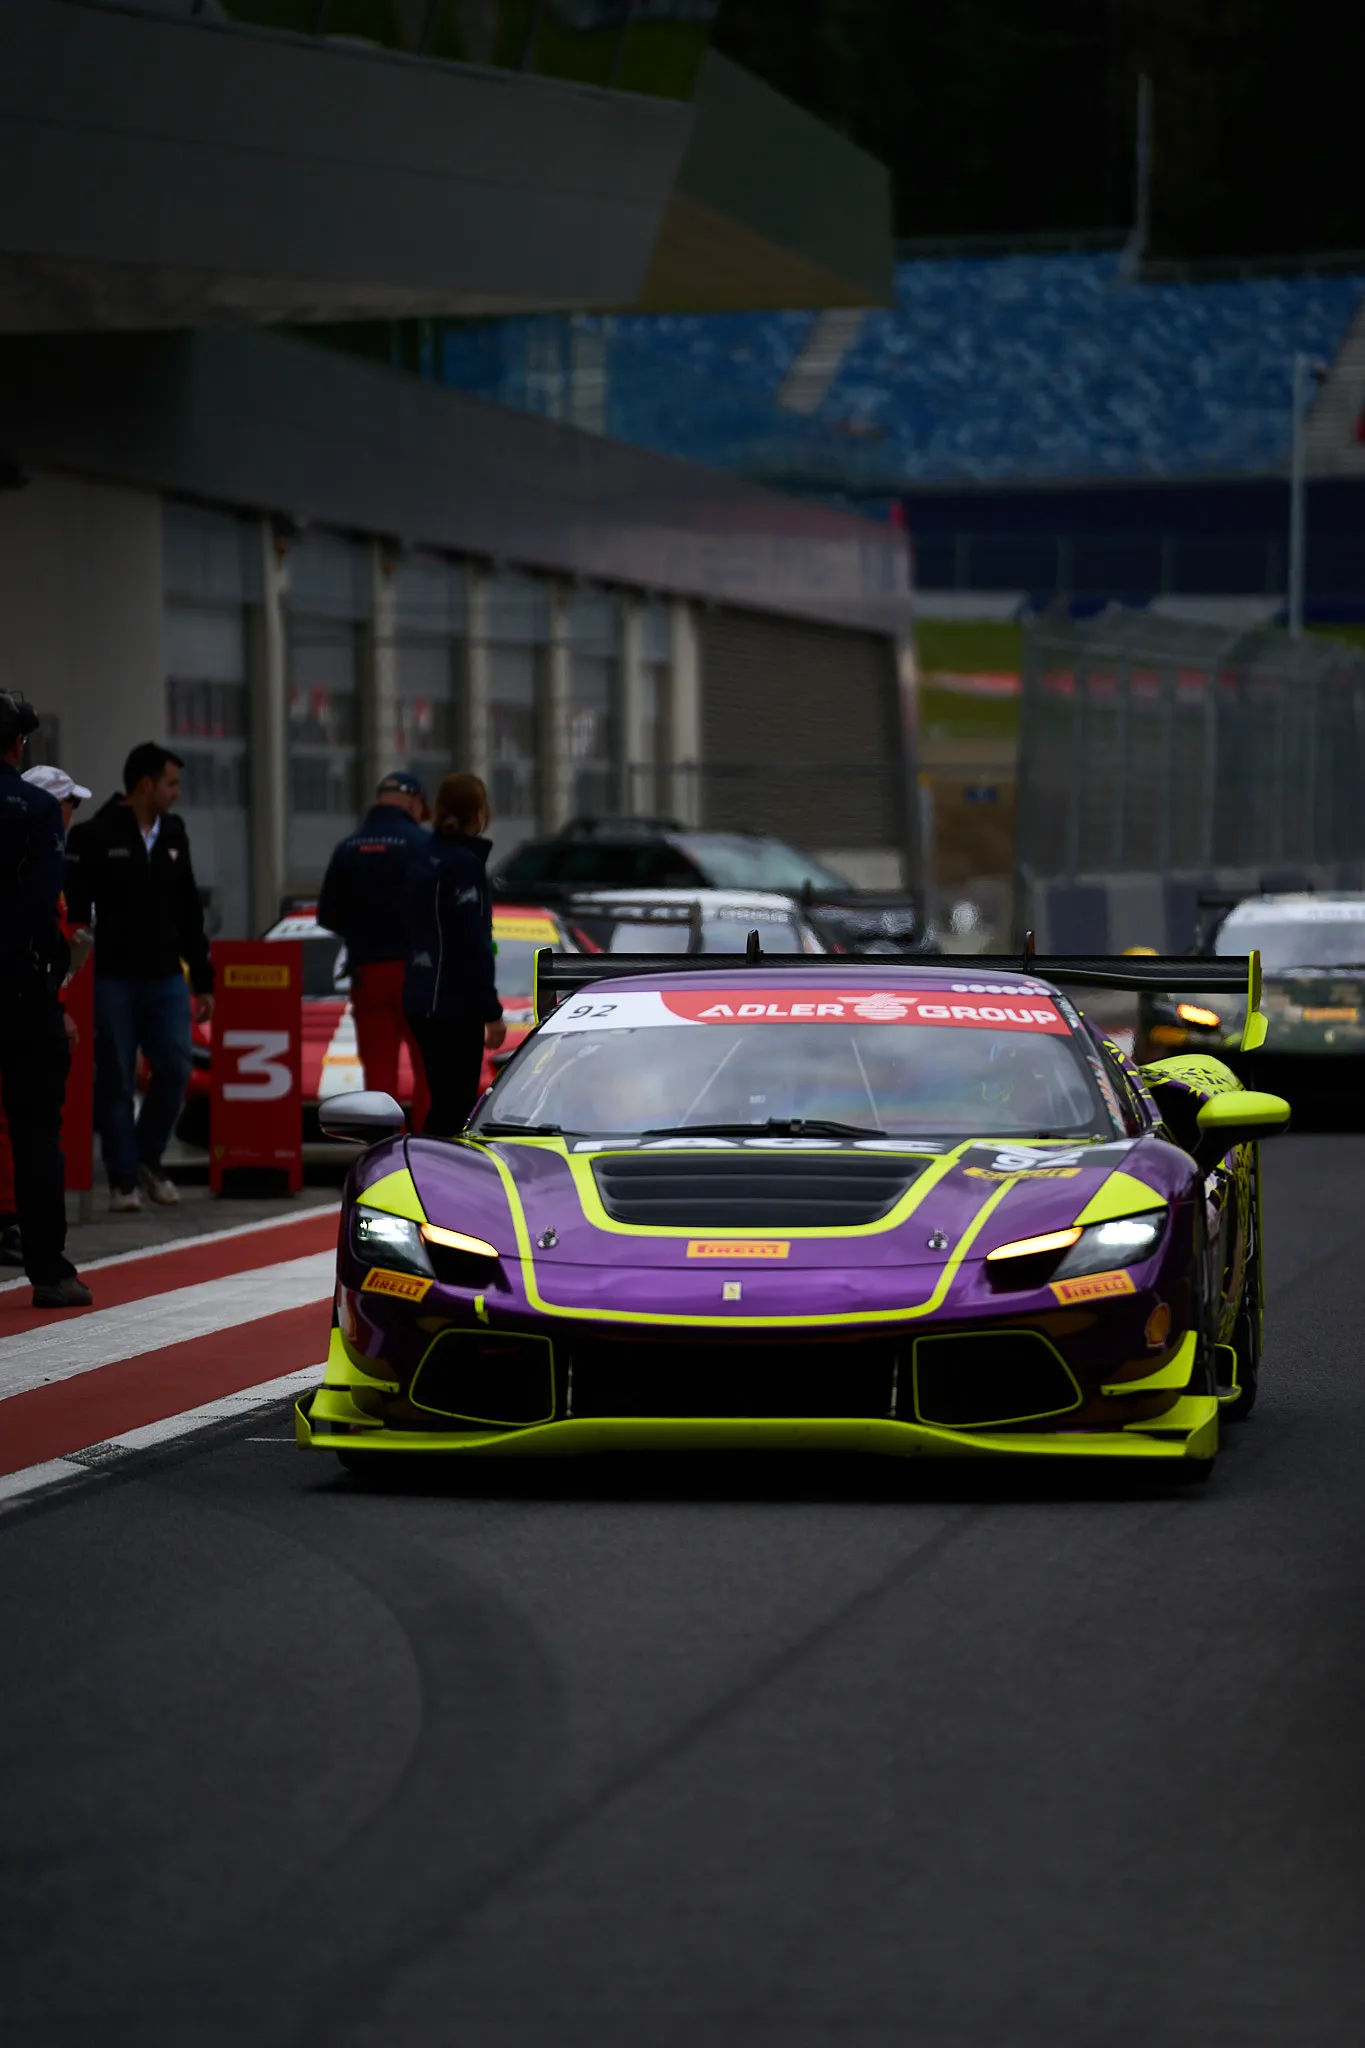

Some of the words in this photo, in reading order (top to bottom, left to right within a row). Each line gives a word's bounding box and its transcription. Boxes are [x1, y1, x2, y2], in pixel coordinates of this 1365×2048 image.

[567, 1005, 618, 1019] 92
[697, 1003, 845, 1018] ADLER
[916, 1005, 1058, 1025] GROUP
[222, 1029, 294, 1102] 3
[991, 1151, 1084, 1171] 92
[697, 1244, 779, 1254] PIRELLI
[367, 1271, 425, 1297] PIRELLI
[1060, 1274, 1128, 1299] PIRELLI
